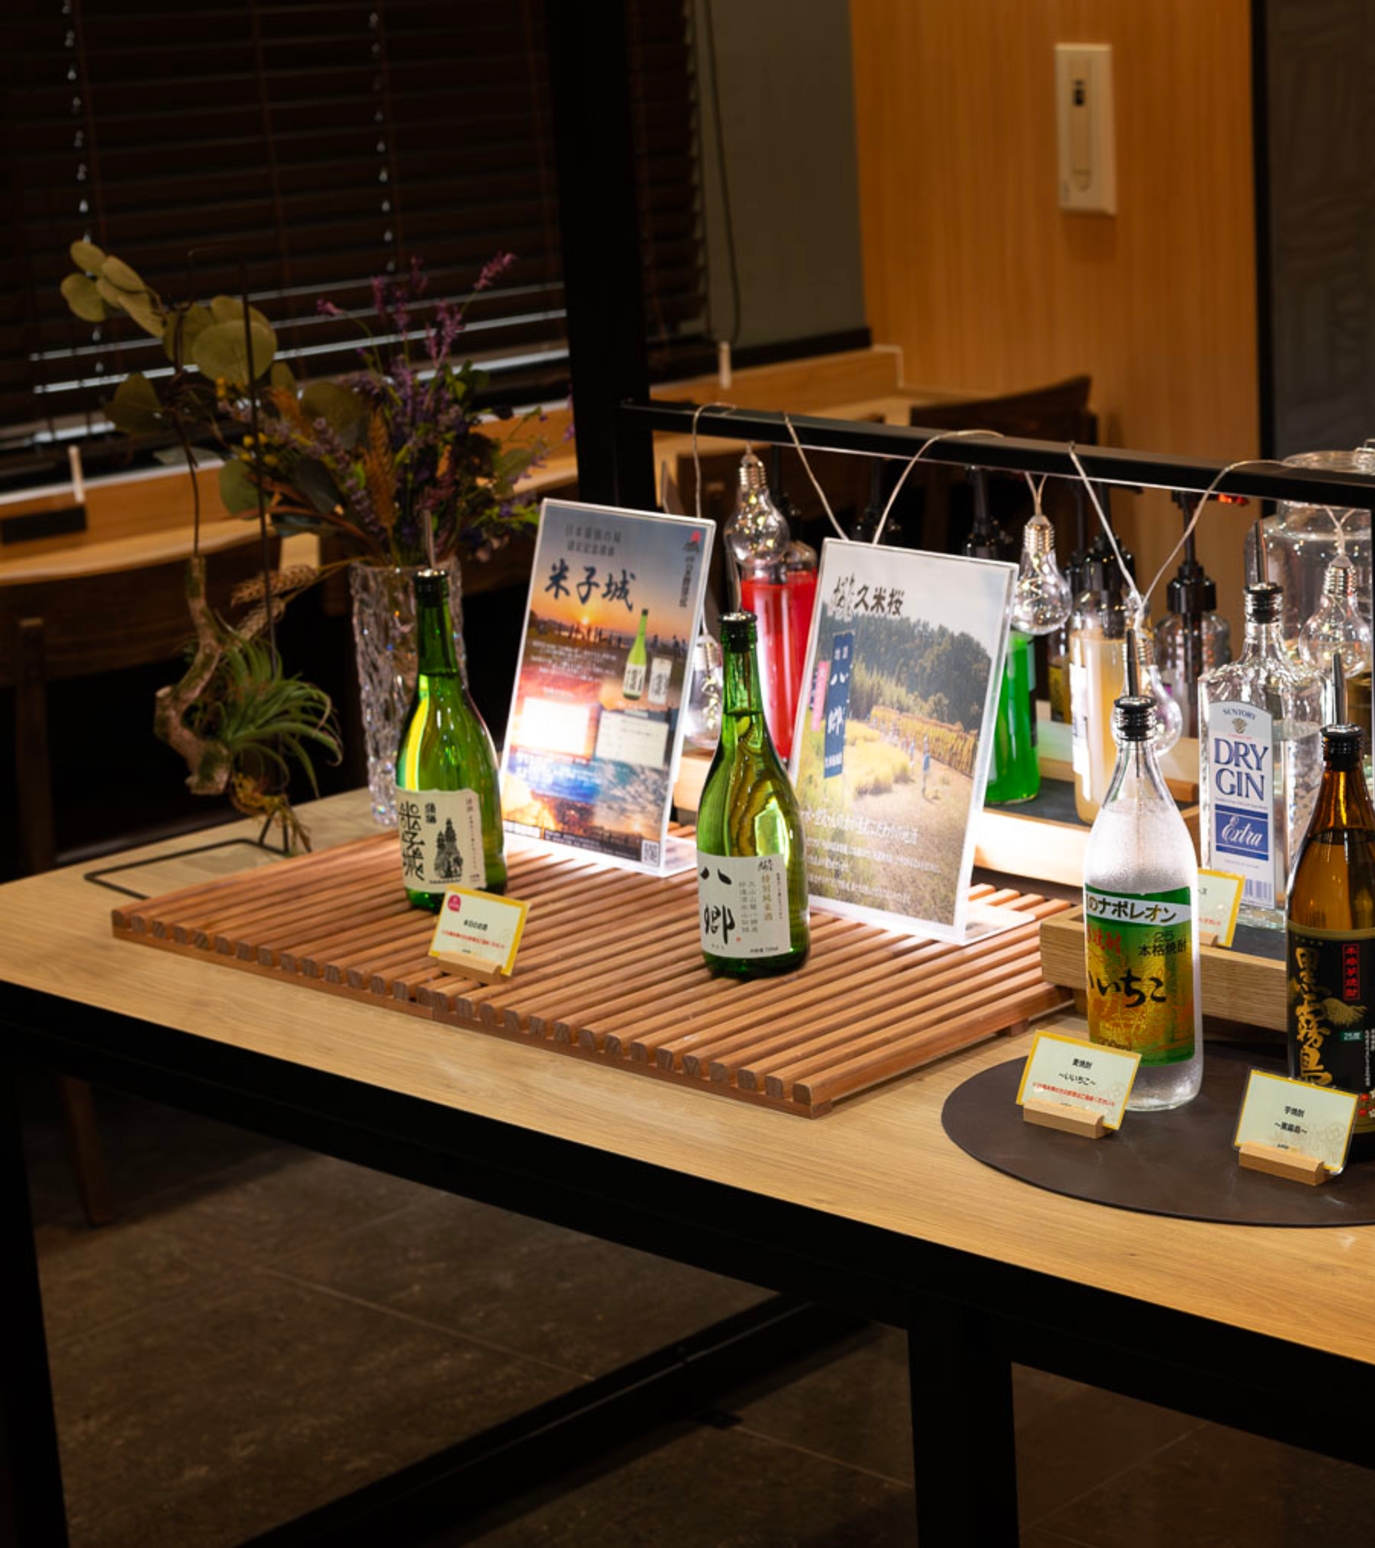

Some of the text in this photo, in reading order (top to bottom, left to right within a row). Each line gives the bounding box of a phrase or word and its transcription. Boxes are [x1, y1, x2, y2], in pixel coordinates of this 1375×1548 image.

[545, 558, 636, 611] 米子城
[854, 583, 904, 616] 久米桜
[1222, 708, 1256, 720] SUNTORY
[1214, 737, 1269, 771] DRY
[1215, 767, 1265, 801] GIN
[1221, 813, 1263, 847] Extra
[1138, 938, 1187, 957] 本格焼酎
[1072, 1058, 1093, 1070] 麦焼酎
[1284, 1106, 1306, 1118] 芋焼酎
